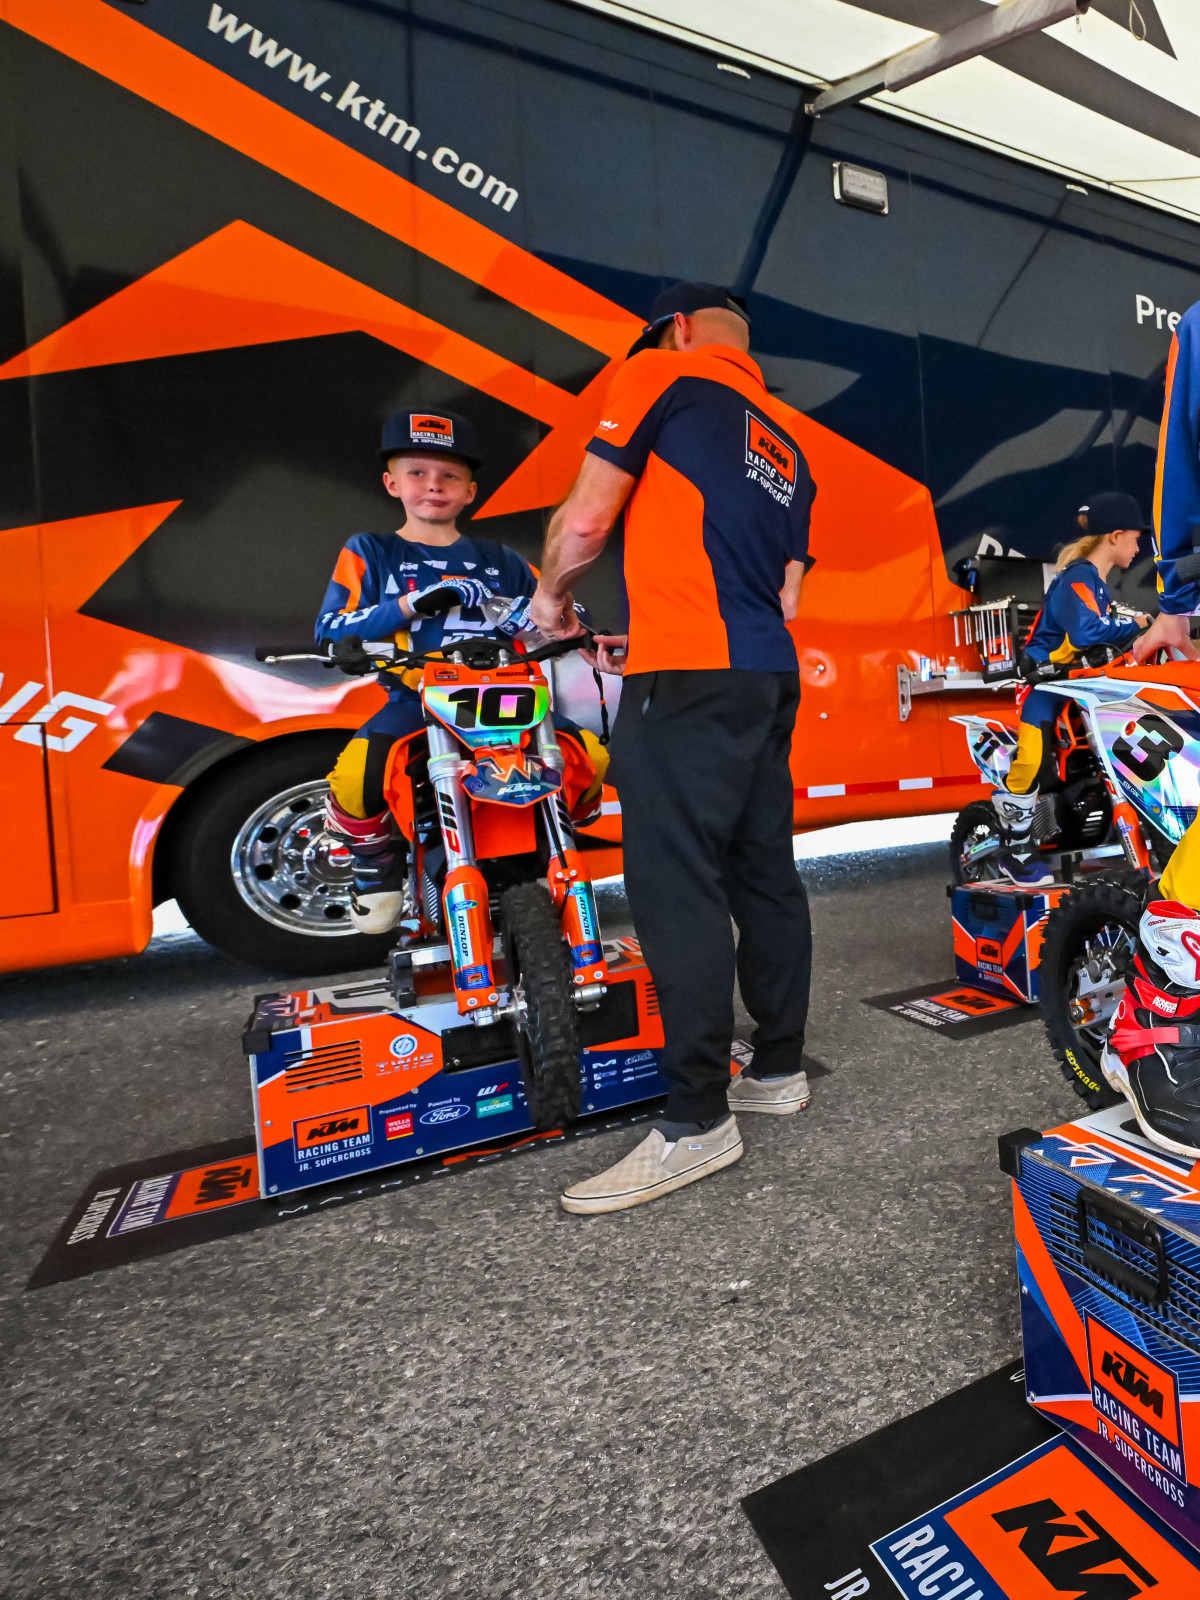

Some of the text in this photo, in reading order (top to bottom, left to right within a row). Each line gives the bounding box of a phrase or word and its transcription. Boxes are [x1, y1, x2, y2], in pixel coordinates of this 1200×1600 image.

[205, 3, 520, 213] www.ktm.com
[748, 451, 776, 479] RACING
[758, 436, 789, 469] KTM
[448, 687, 536, 729] 10
[579, 896, 591, 936] DUNLOP
[457, 915, 469, 957] DUNLOP
[375, 1053, 434, 1072] TWIG
[388, 1117, 411, 1127] WELLS
[429, 1106, 461, 1122] Ford
[479, 1099, 510, 1114] MOTOREX
[306, 1118, 360, 1141] KTM
[388, 1123, 411, 1132] FARGO
[297, 1134, 371, 1160] RACING TEAM
[299, 1147, 372, 1172] JR. SUPERCROSS
[194, 1165, 252, 1206] KTM
[1101, 1350, 1164, 1419] KTM
[1093, 1385, 1183, 1476] RACING TEAM
[1097, 1419, 1186, 1509] JR. SUPERCROSS
[888, 1524, 985, 1600] RACI
[991, 1497, 1160, 1600] KT
